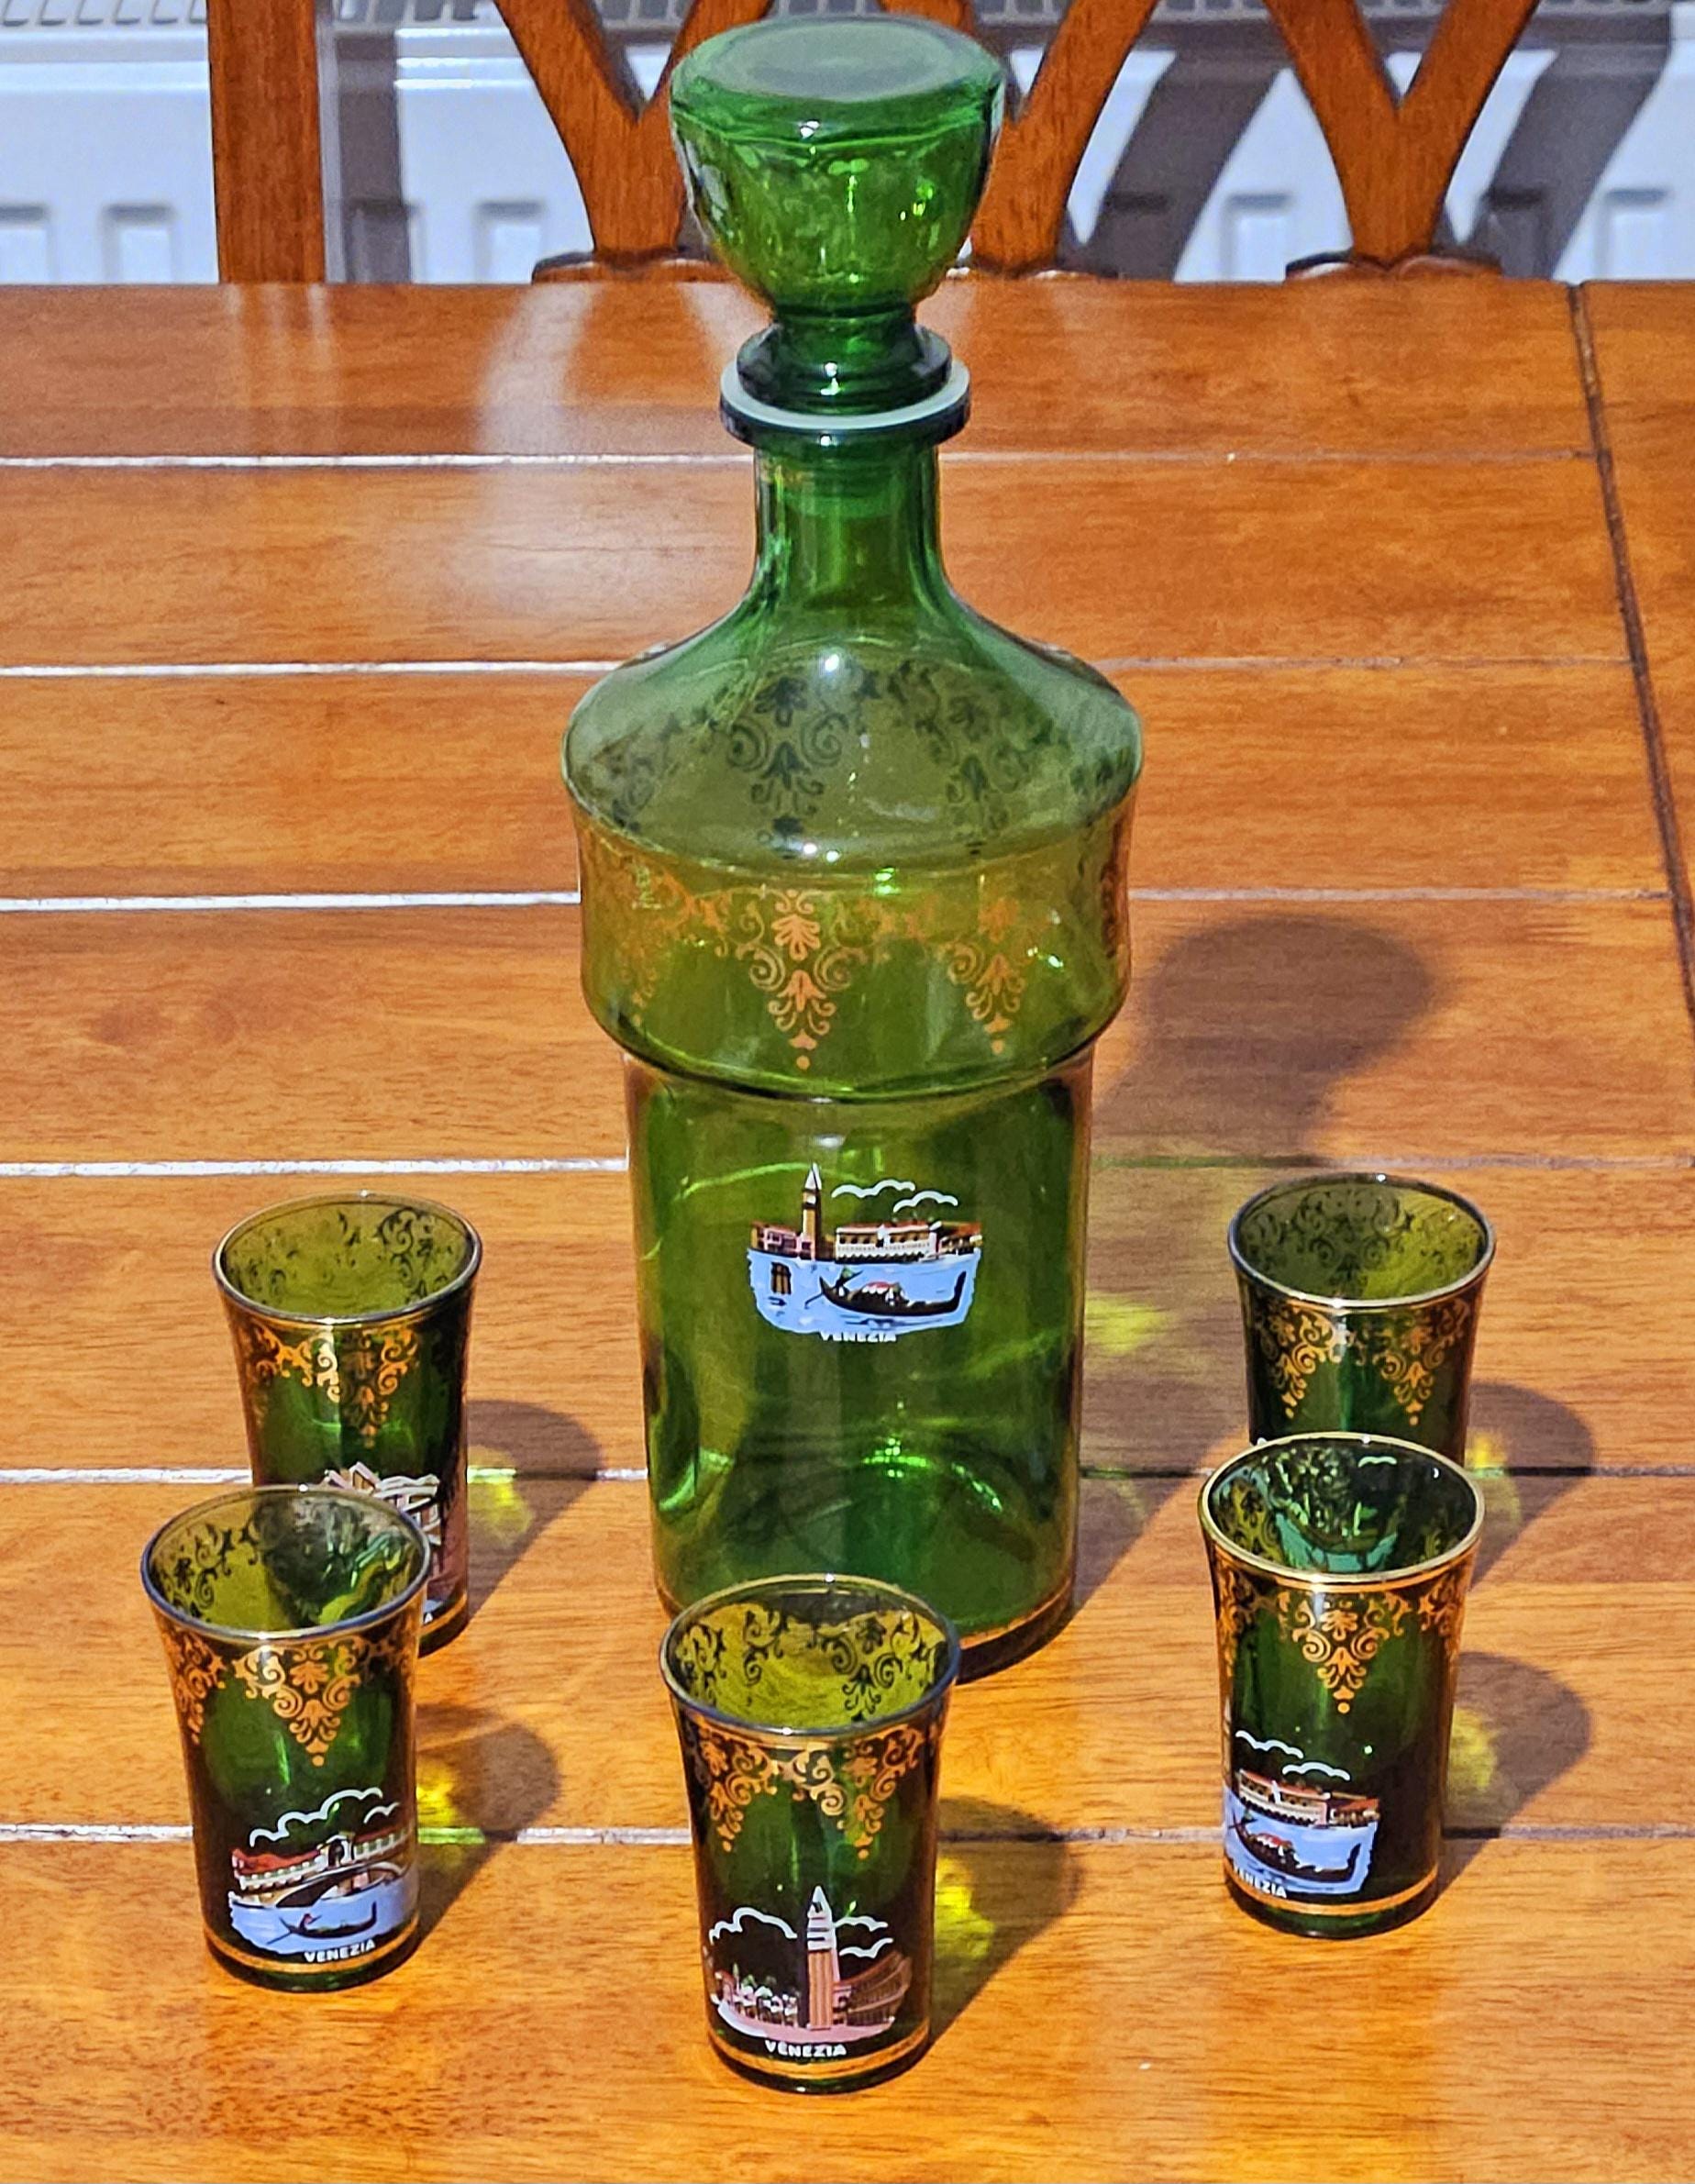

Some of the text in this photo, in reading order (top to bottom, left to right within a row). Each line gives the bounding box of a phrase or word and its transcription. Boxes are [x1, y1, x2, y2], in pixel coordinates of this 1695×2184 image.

[820, 1329, 897, 1342] VENEZIA
[304, 1938, 376, 1963] VENEZIA
[764, 2039, 848, 2057] VENEZIA
